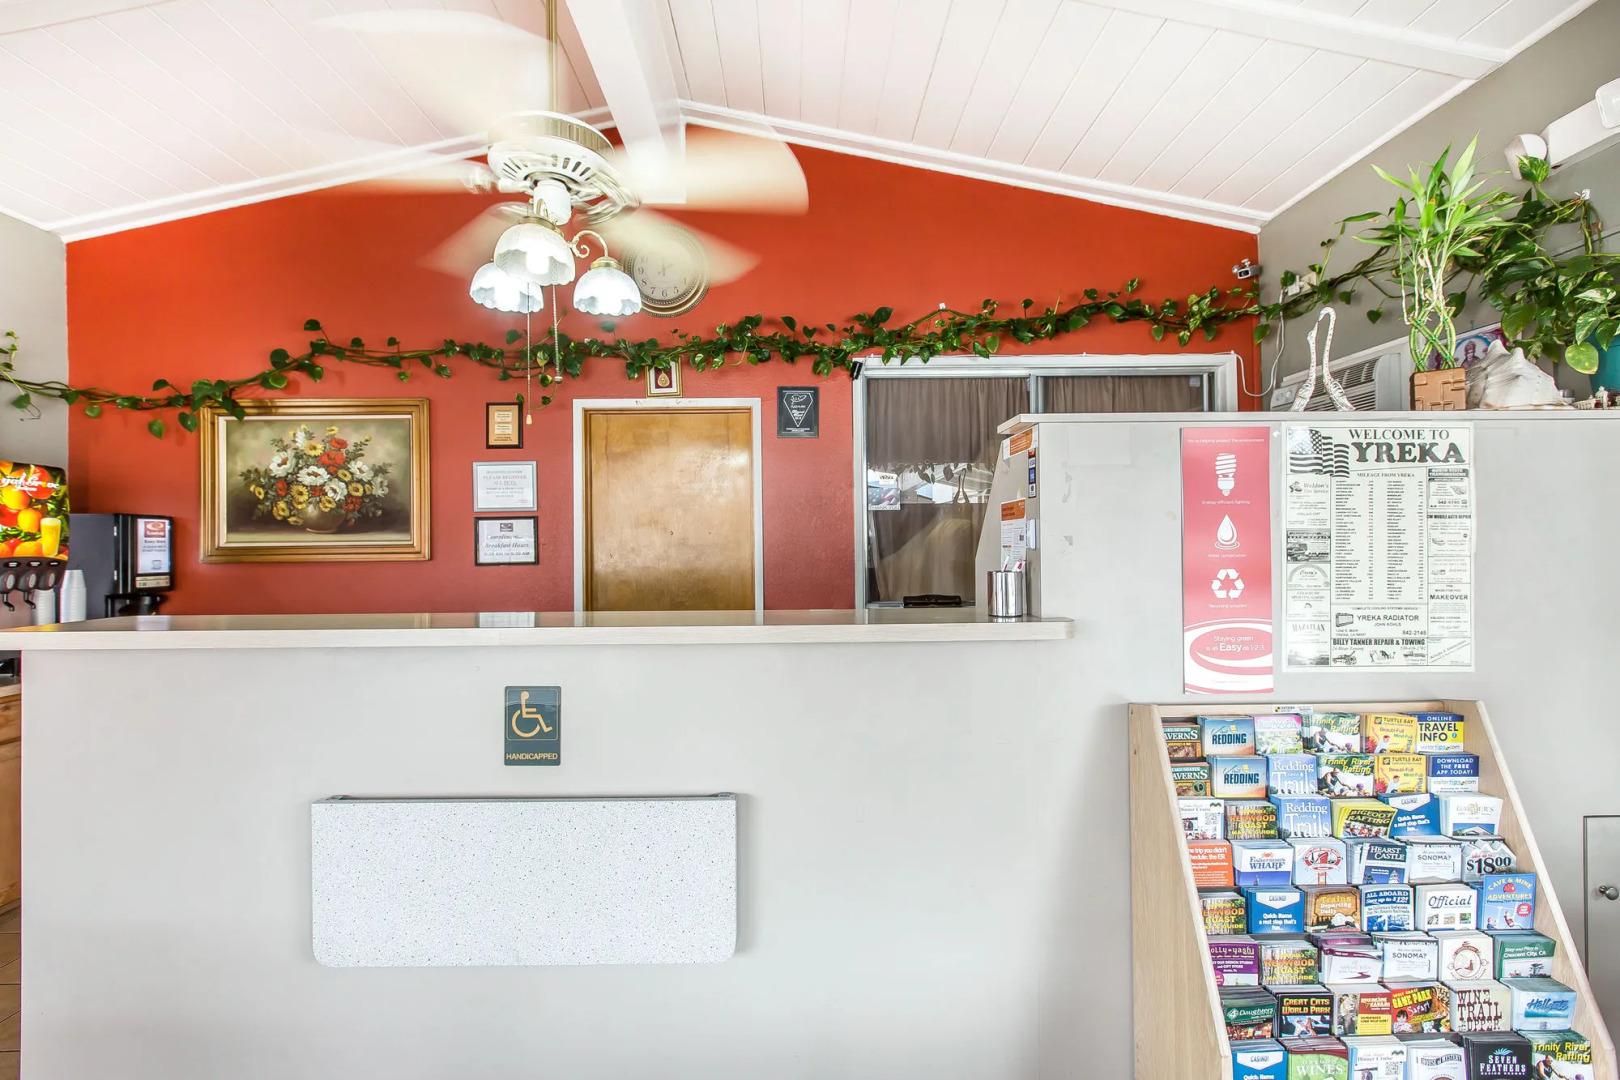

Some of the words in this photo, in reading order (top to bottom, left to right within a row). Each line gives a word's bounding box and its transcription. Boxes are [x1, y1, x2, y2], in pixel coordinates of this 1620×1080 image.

[1349, 429, 1425, 440] WELCOME
[1429, 429, 1449, 440] TO
[1351, 442, 1466, 463] YREKA
[1220, 643, 1242, 652] Easy
[1331, 725, 1359, 734] Rafting
[1419, 723, 1458, 732] TRAVEL
[1164, 730, 1198, 740] AVERNS
[1212, 734, 1246, 744] REDDING
[1420, 733, 1448, 741] INFO
[1274, 761, 1314, 772] Redding
[1343, 766, 1371, 775] Rafting
[1174, 769, 1208, 780] AVERNS
[1224, 773, 1259, 784] REDDING
[1272, 771, 1315, 794] Trails
[1286, 803, 1328, 814] Redding
[1350, 810, 1393, 818] BIGFOOT
[1285, 813, 1329, 838] Trails
[1488, 879, 1505, 890] CAVE
[1516, 878, 1532, 890] MINE
[1428, 895, 1472, 909] Official
[1392, 996, 1412, 1009] GAME
[1413, 989, 1432, 1003] PARK
[1457, 990, 1490, 1004] WINE
[1240, 1008, 1274, 1016] Daughters
[1458, 1002, 1502, 1021] TRAIL
[1533, 1043, 1560, 1052] Trinity
[1565, 1042, 1590, 1051] River
[1556, 1052, 1591, 1063] Rafting
[1296, 1064, 1343, 1076] WINES
[1480, 1064, 1526, 1072] FEATHERS
